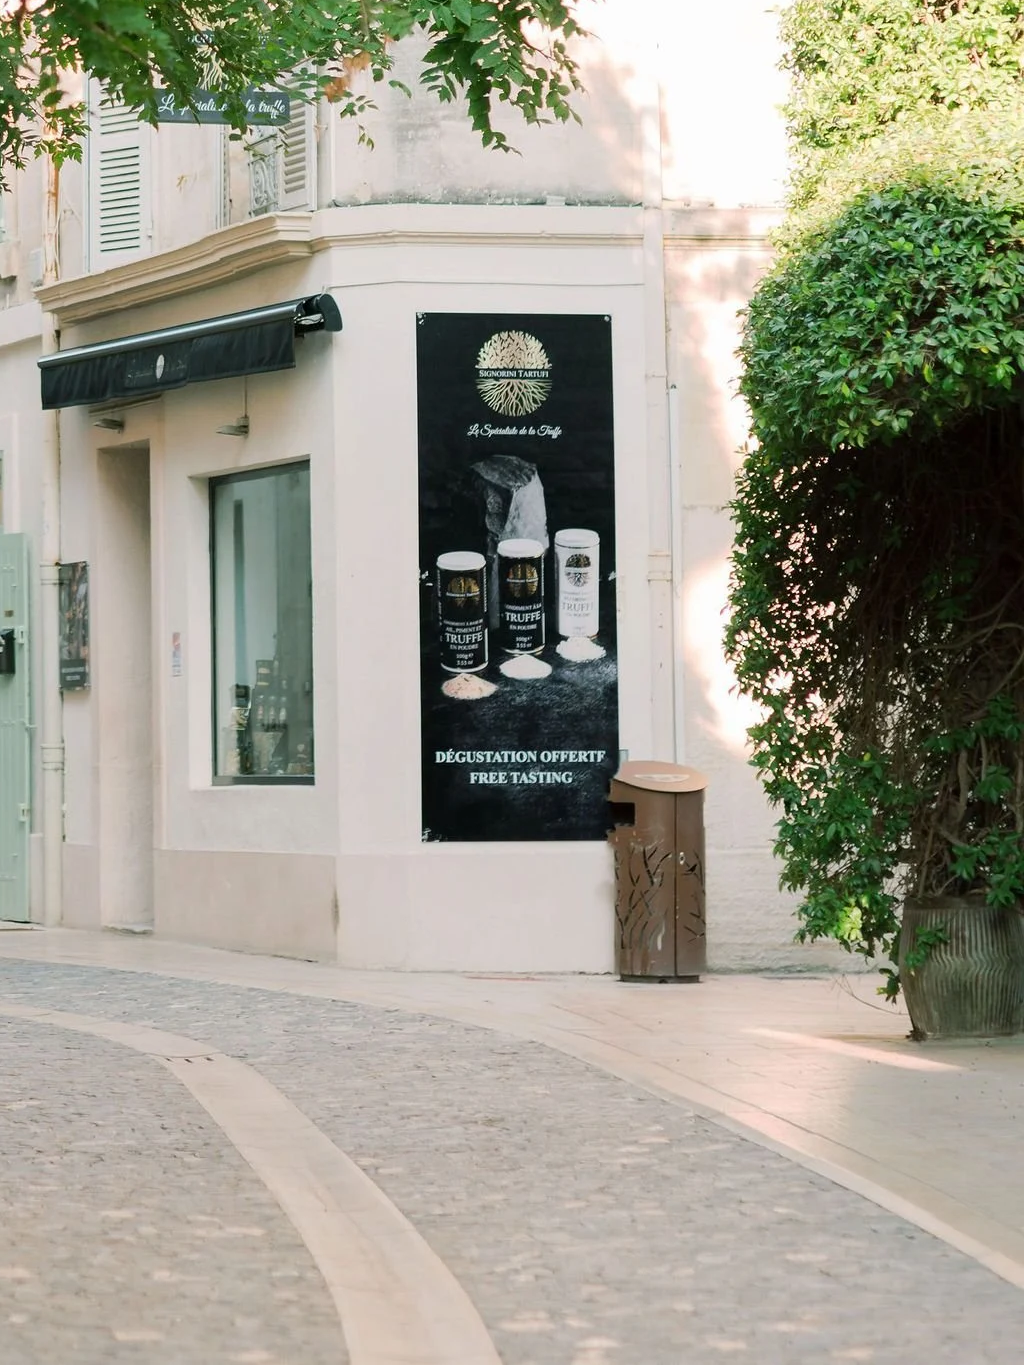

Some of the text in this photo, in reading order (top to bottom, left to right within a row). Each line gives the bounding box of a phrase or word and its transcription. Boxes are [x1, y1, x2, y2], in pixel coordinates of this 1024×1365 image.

[258, 99, 286, 119] truffe
[478, 369, 549, 378] SIGNORINI TARTUFI
[467, 423, 480, 438] Le
[519, 426, 527, 435] de
[528, 426, 536, 435] la
[537, 425, 562, 439] Truffe
[505, 611, 541, 623] TRUFFE
[445, 632, 483, 644] TRUFFE
[435, 748, 538, 764] DÉGUSTATION
[469, 771, 573, 784] FREE TASTING
